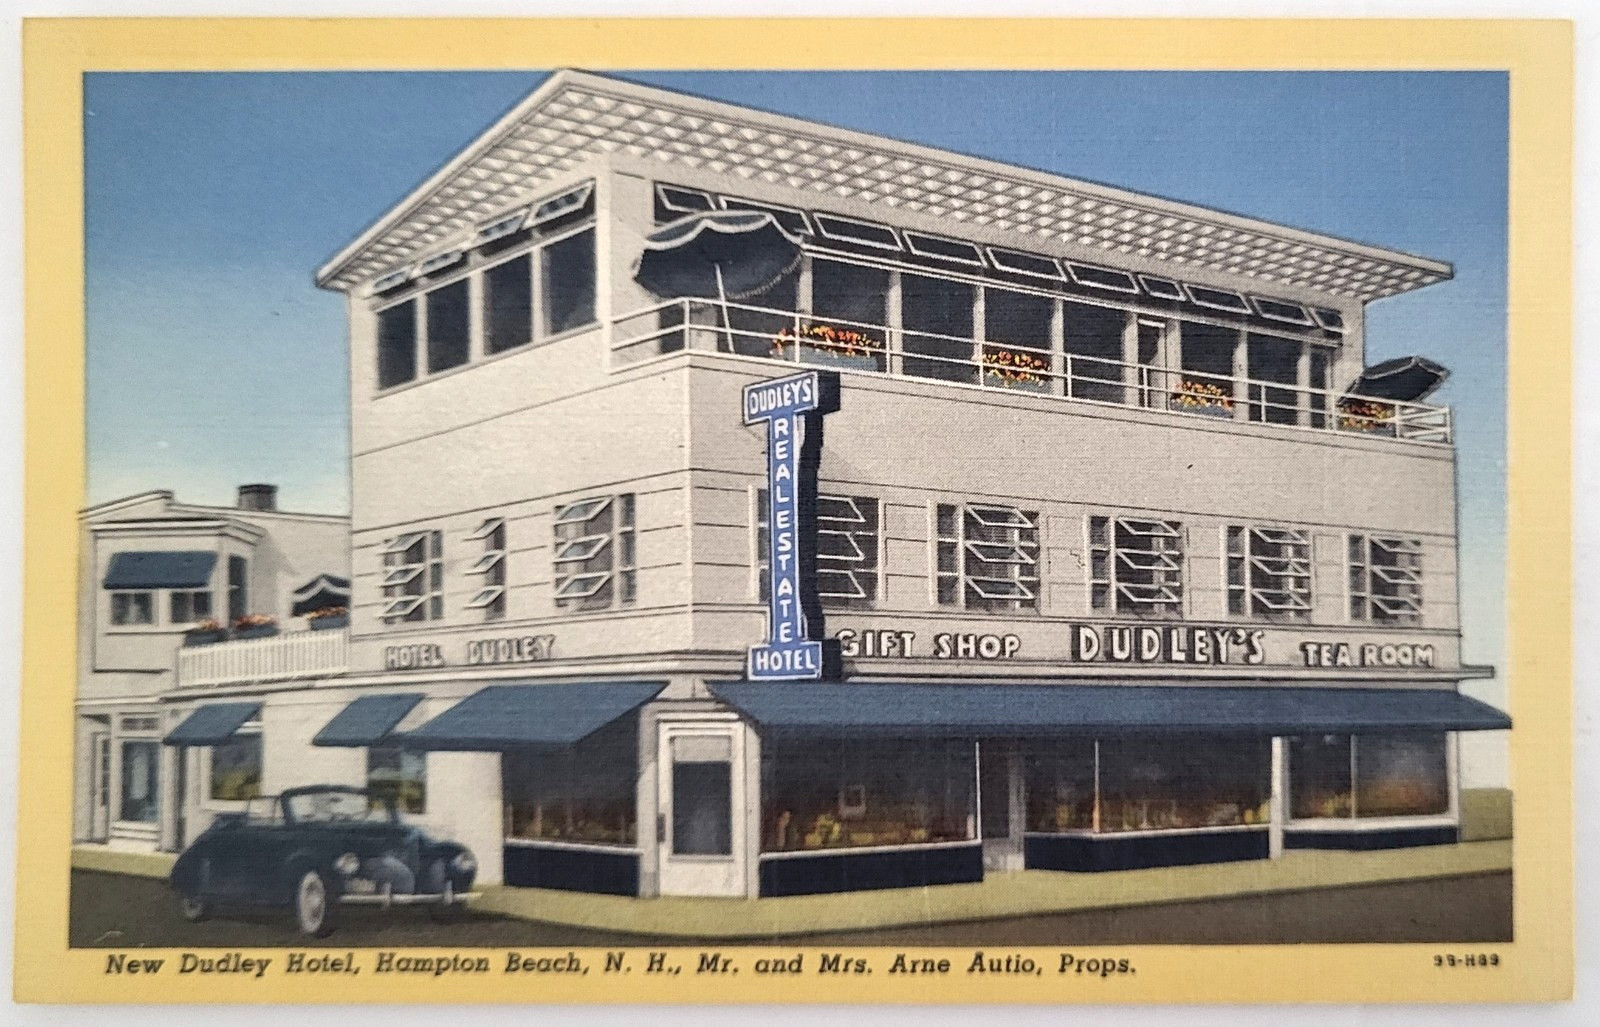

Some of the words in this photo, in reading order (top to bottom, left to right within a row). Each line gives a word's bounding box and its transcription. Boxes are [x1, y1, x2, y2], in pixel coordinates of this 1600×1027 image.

[774, 417, 791, 503] REAL
[776, 510, 793, 643] ESTATE
[385, 644, 445, 670] HOTEL
[467, 633, 557, 666] DUDLEY
[755, 648, 817, 672] HOTEL
[835, 628, 916, 658] GIFT
[934, 632, 1022, 660] SHOP
[1300, 642, 1351, 667] TEA
[1361, 643, 1435, 669] ROOM
[104, 953, 165, 974] New
[179, 952, 272, 977] Dudley
[285, 952, 361, 975] Hotel,
[375, 952, 491, 977] Hampton
[504, 951, 591, 975] Beach,
[604, 951, 632, 973] N.
[646, 952, 683, 975] H.,
[697, 952, 740, 974] Mr.
[754, 952, 804, 974] and
[818, 952, 873, 974] Mrs.
[888, 952, 951, 974] Arne
[966, 951, 1043, 975] Autio,
[1057, 952, 1137, 977] Props.
